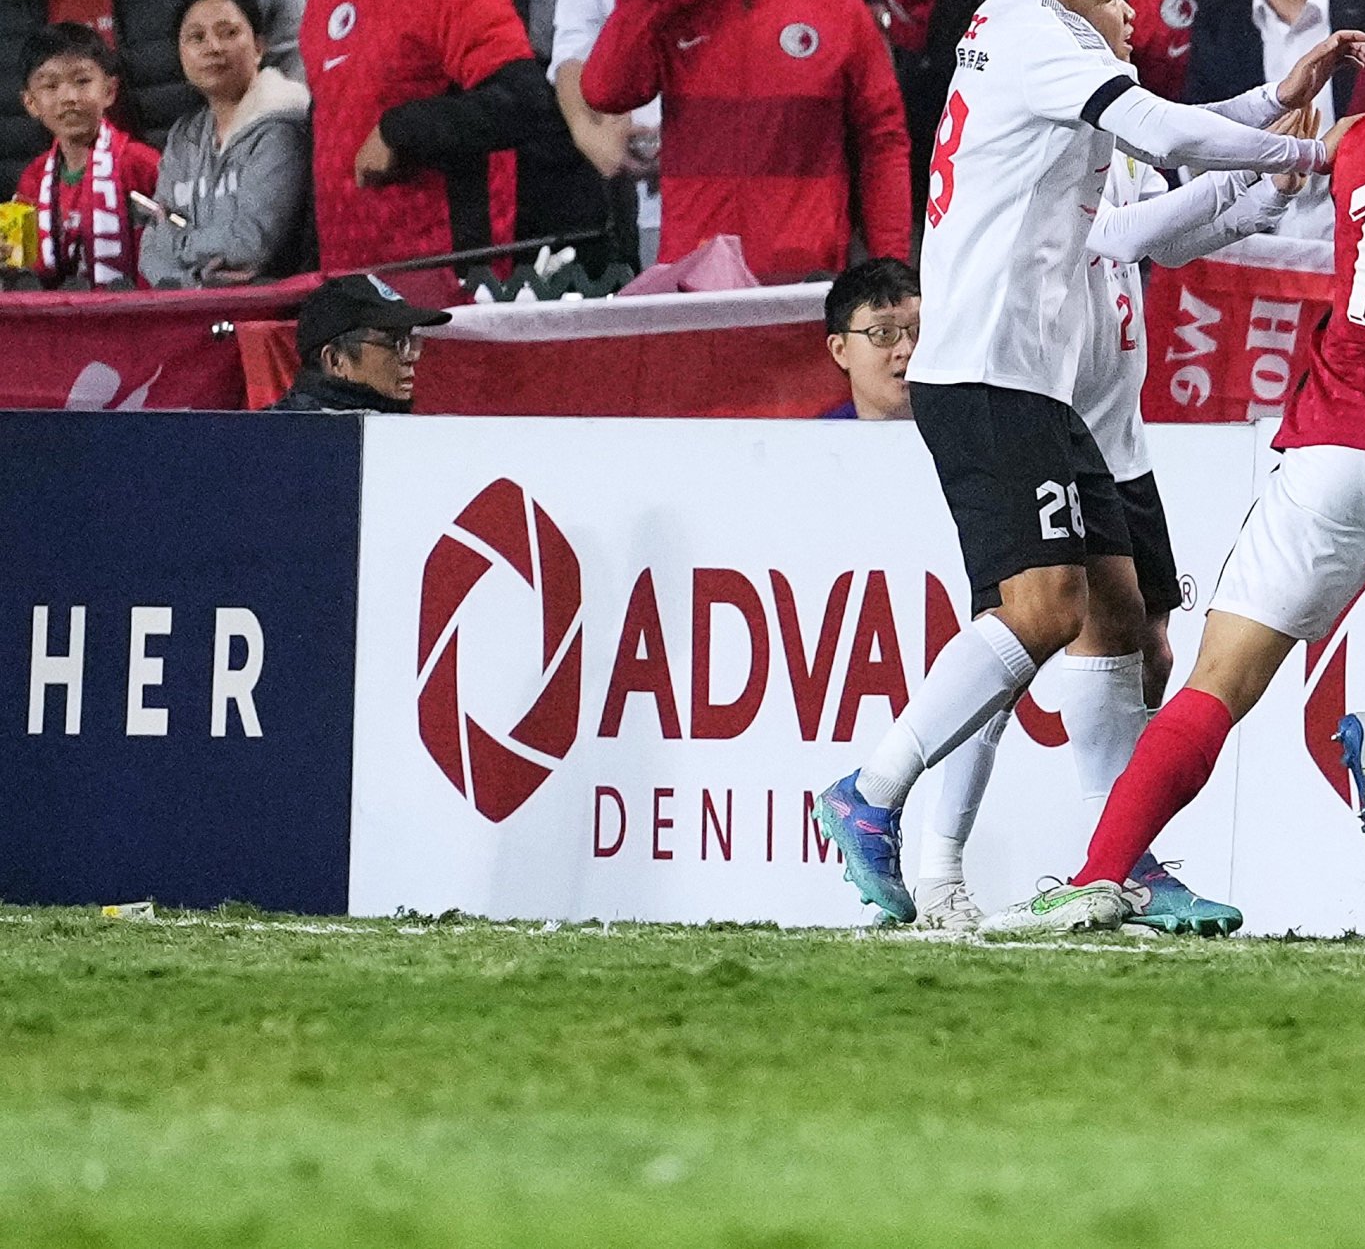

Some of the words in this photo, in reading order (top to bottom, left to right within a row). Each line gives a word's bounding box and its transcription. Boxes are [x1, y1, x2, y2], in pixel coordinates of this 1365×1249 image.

[1036, 480, 1086, 540] 28
[27, 605, 265, 738] HER
[597, 567, 1070, 748] ADVA
